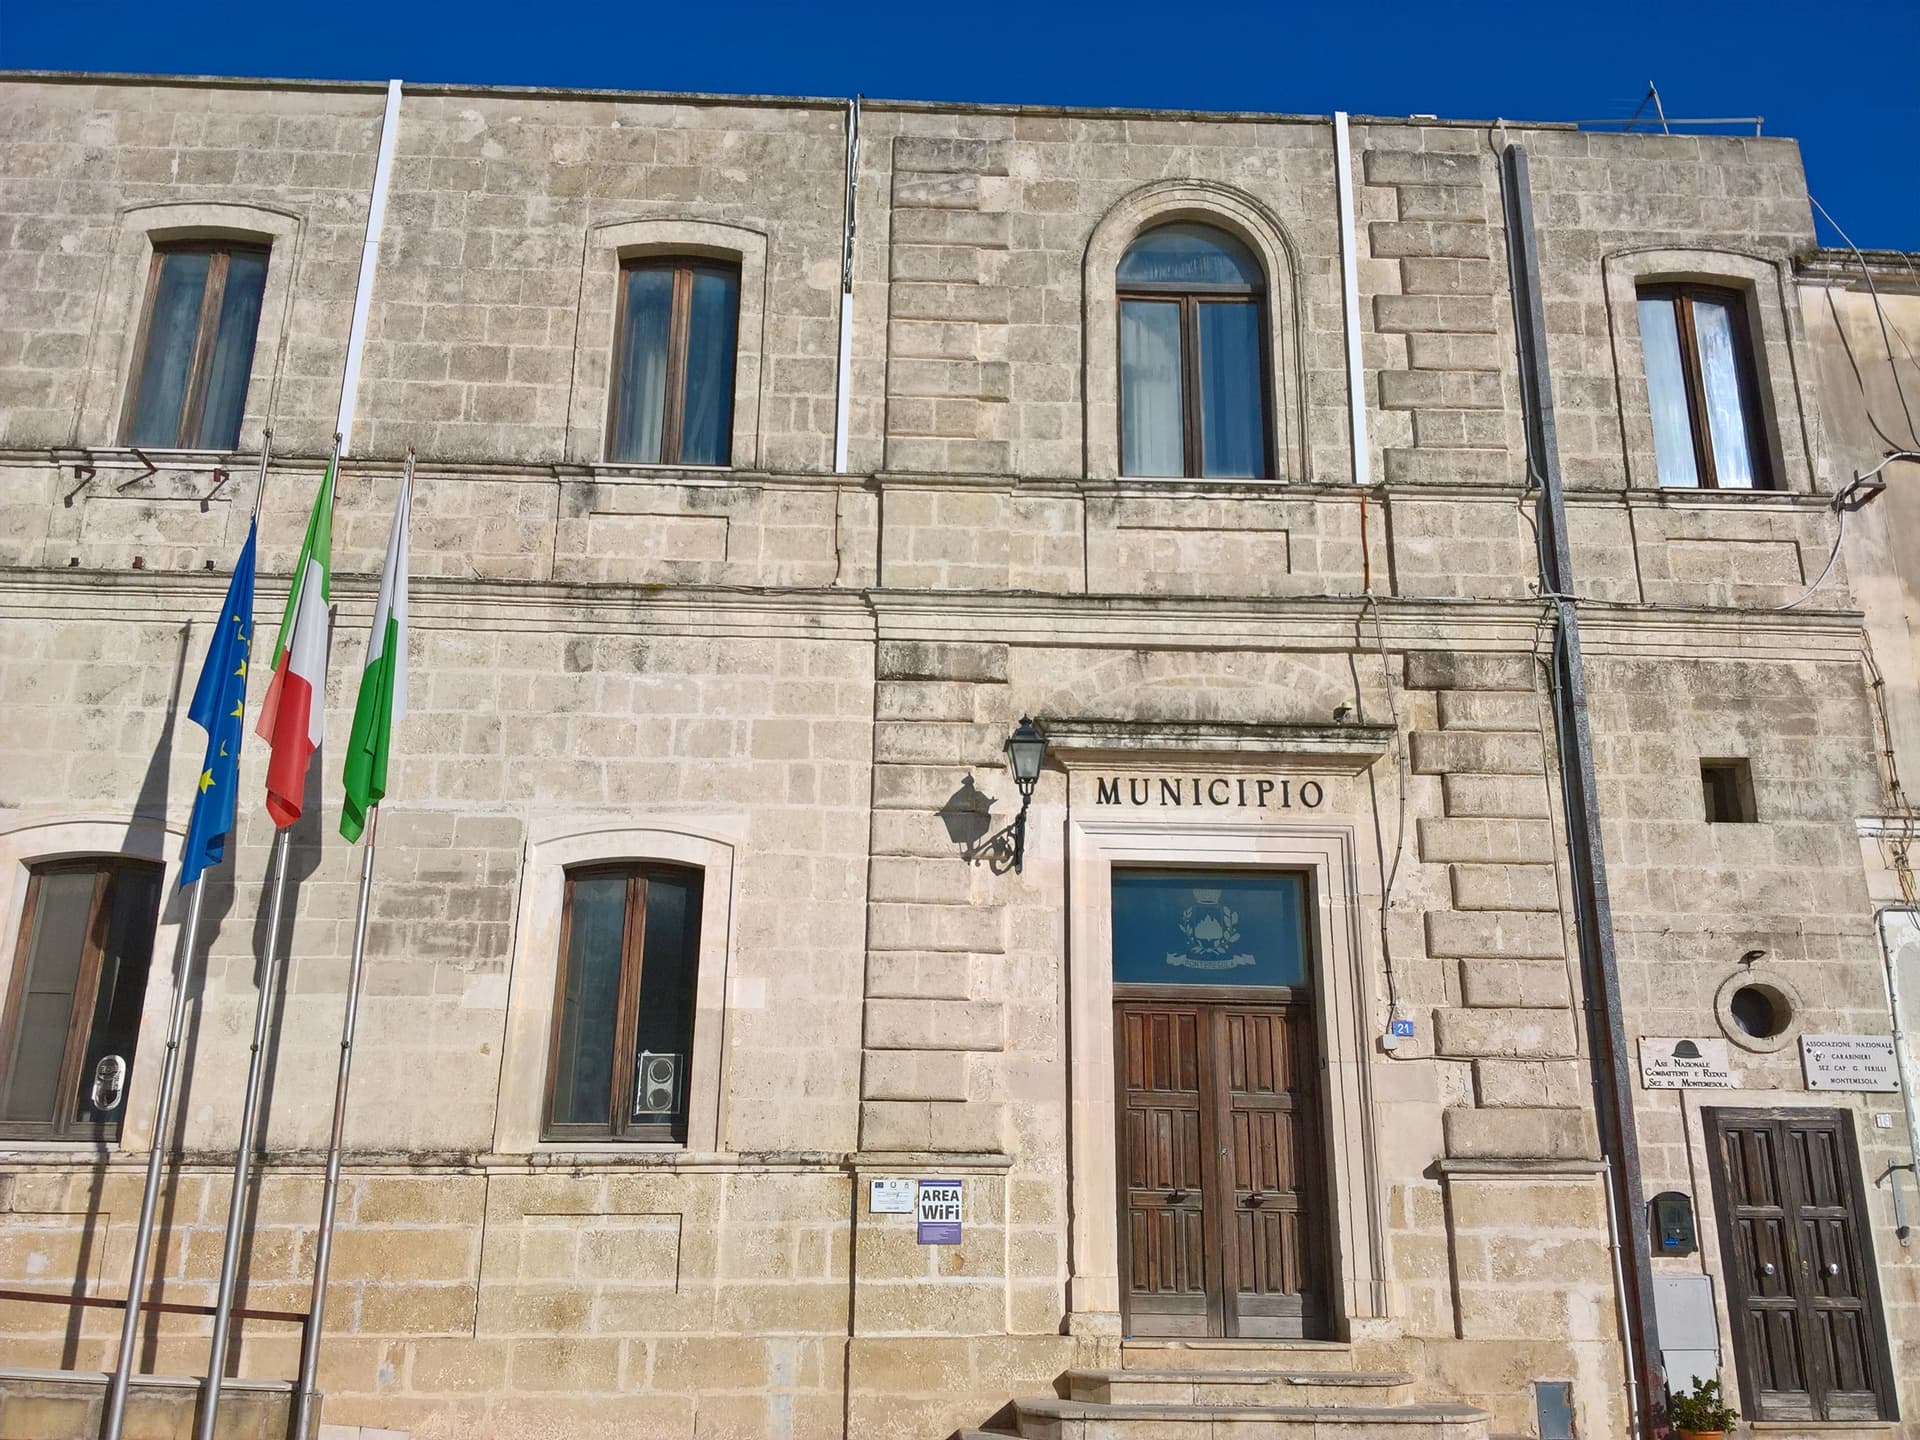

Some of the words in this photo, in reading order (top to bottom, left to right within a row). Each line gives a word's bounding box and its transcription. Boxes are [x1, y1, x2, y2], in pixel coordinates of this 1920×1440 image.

[1096, 777, 1324, 808] MUNICIPIO
[1397, 1023, 1409, 1034] 21
[922, 1190, 960, 1202] AREA
[922, 1204, 960, 1220] WiFi
